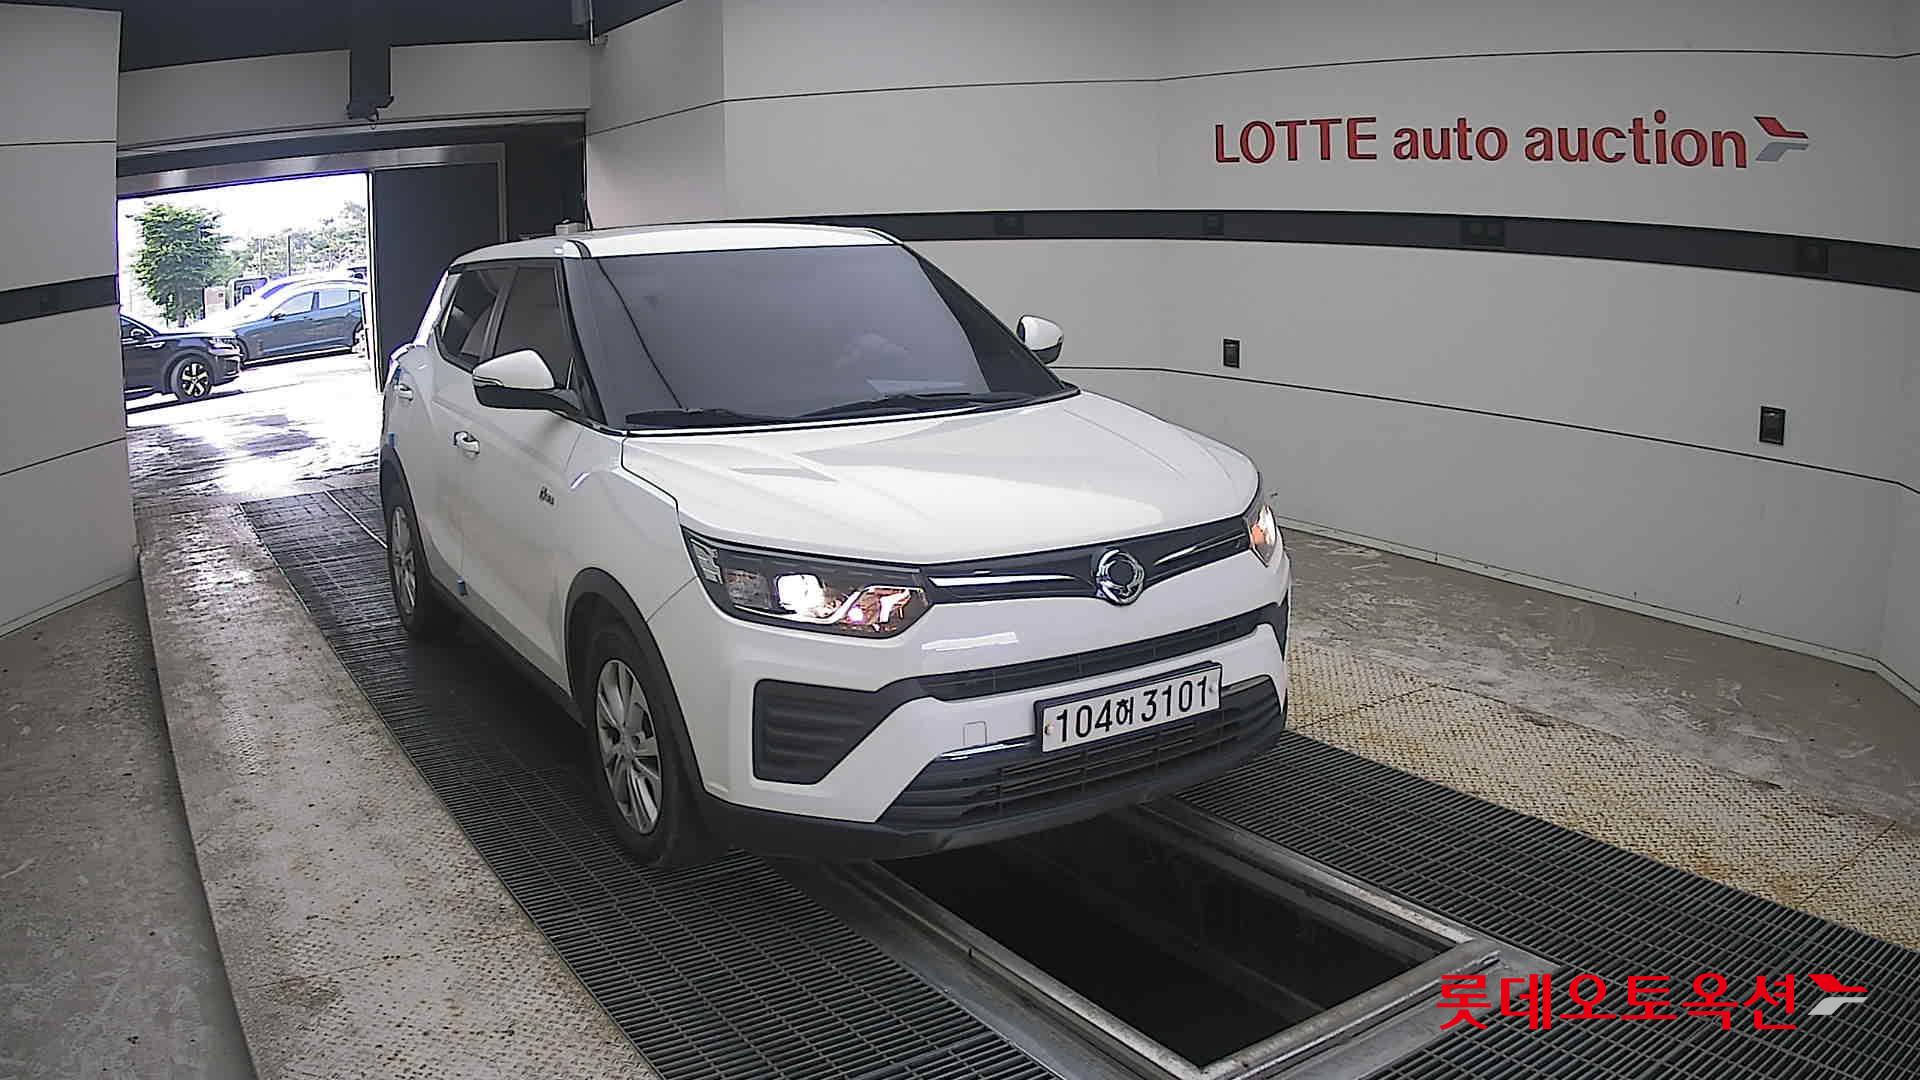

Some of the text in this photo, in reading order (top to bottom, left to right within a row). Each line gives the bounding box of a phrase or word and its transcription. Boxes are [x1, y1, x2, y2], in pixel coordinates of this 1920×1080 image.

[1214, 109, 1748, 168] LOTTE auto auction
